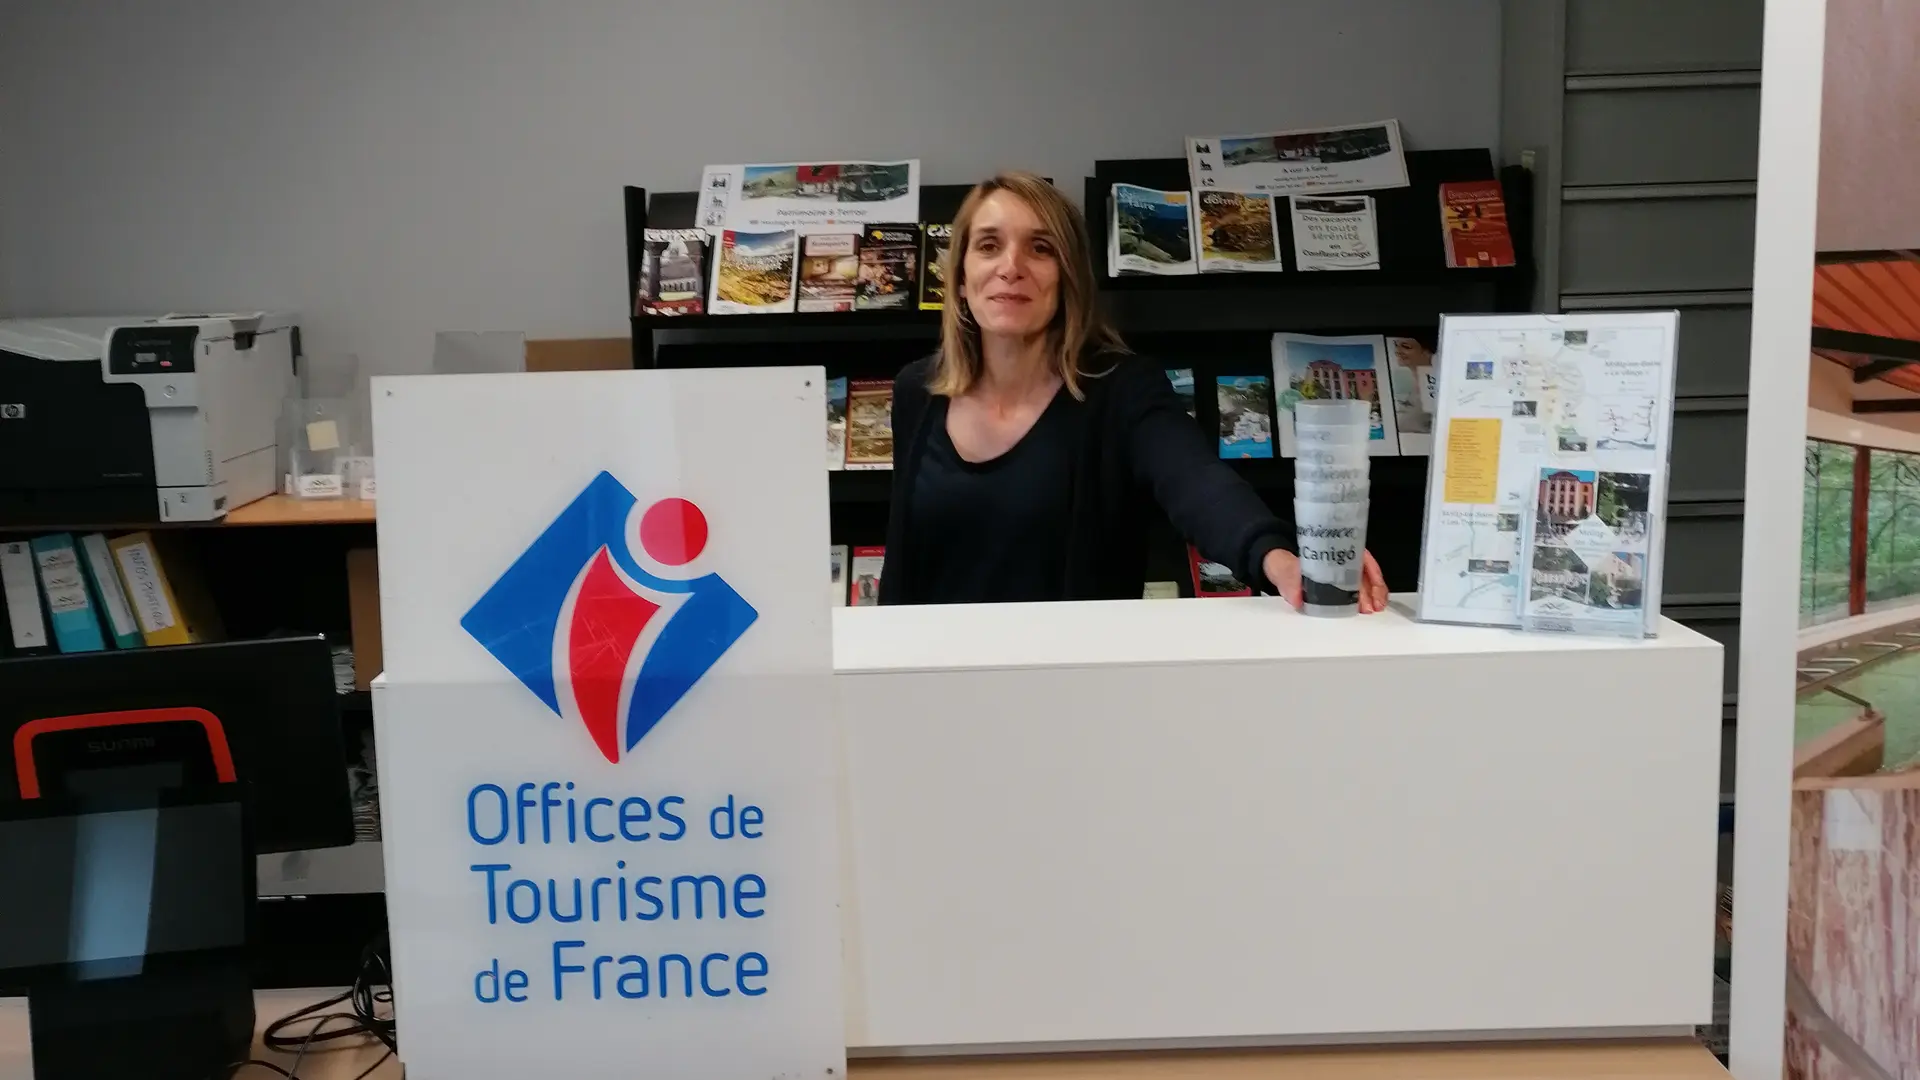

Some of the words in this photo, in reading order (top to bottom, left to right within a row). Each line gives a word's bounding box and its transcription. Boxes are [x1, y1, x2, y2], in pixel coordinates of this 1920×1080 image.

[1302, 546, 1356, 566] Canigó
[467, 781, 687, 845] Offices
[709, 794, 764, 840] de
[470, 860, 766, 924] Tourisme
[474, 958, 529, 1003] de
[553, 940, 769, 1000] France
